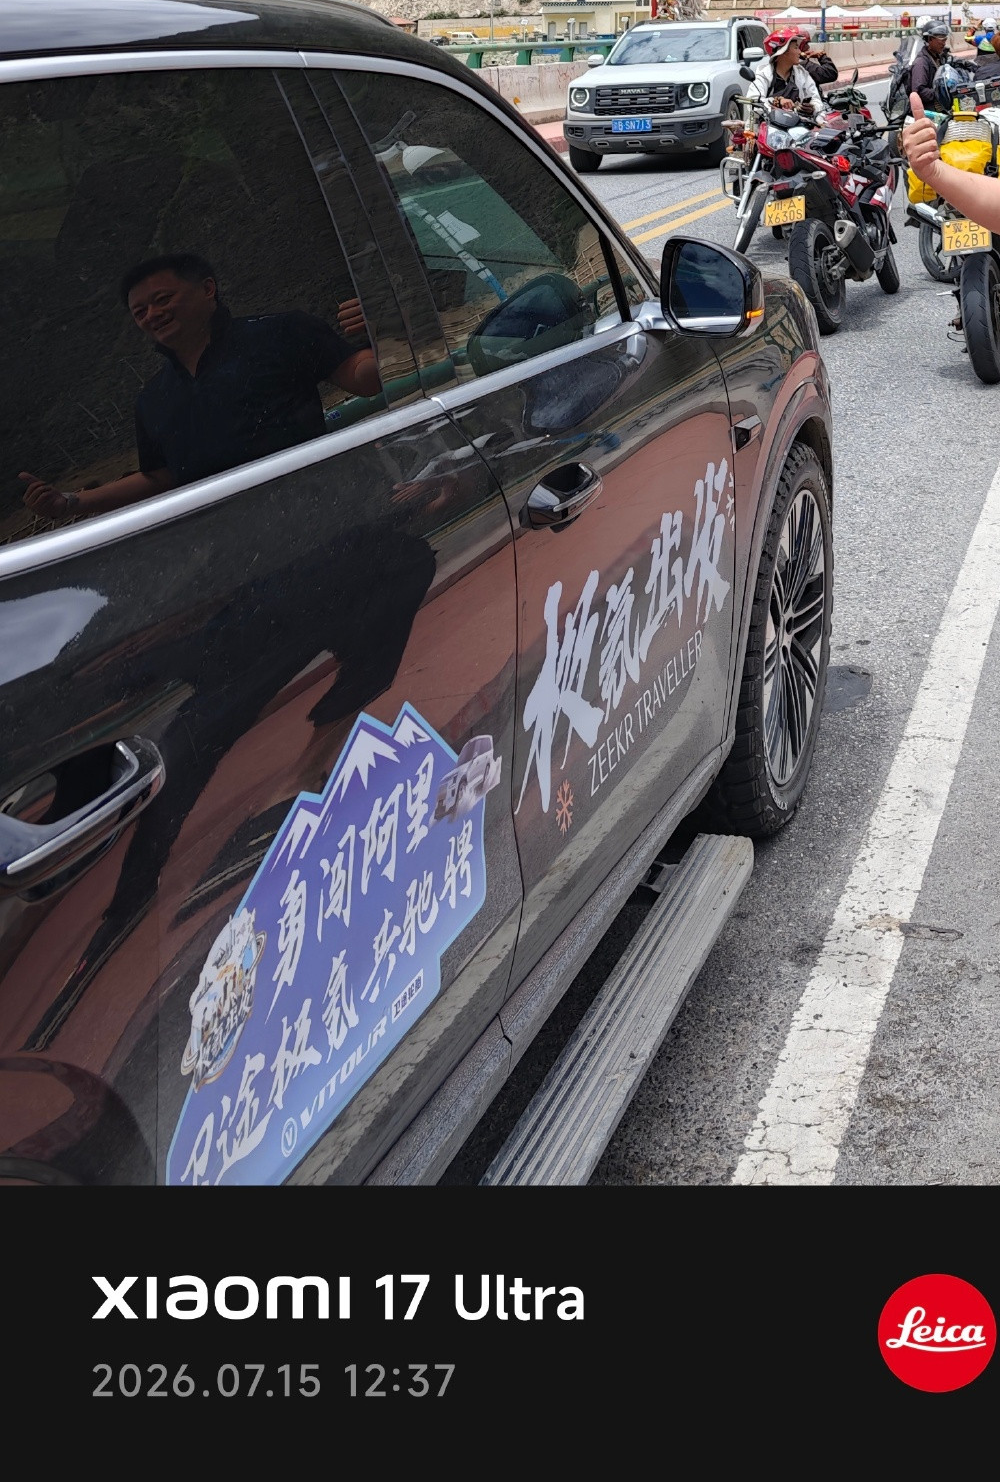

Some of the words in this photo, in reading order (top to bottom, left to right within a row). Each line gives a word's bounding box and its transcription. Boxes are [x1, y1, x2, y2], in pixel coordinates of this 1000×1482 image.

[767, 209, 803, 225] X630S
[946, 231, 987, 249] 762BT
[587, 714, 635, 797] ZEEKR
[634, 630, 703, 734] TRAVELLER
[264, 751, 435, 1026] 勇闯阿里
[300, 1016, 387, 1130] VITOUR
